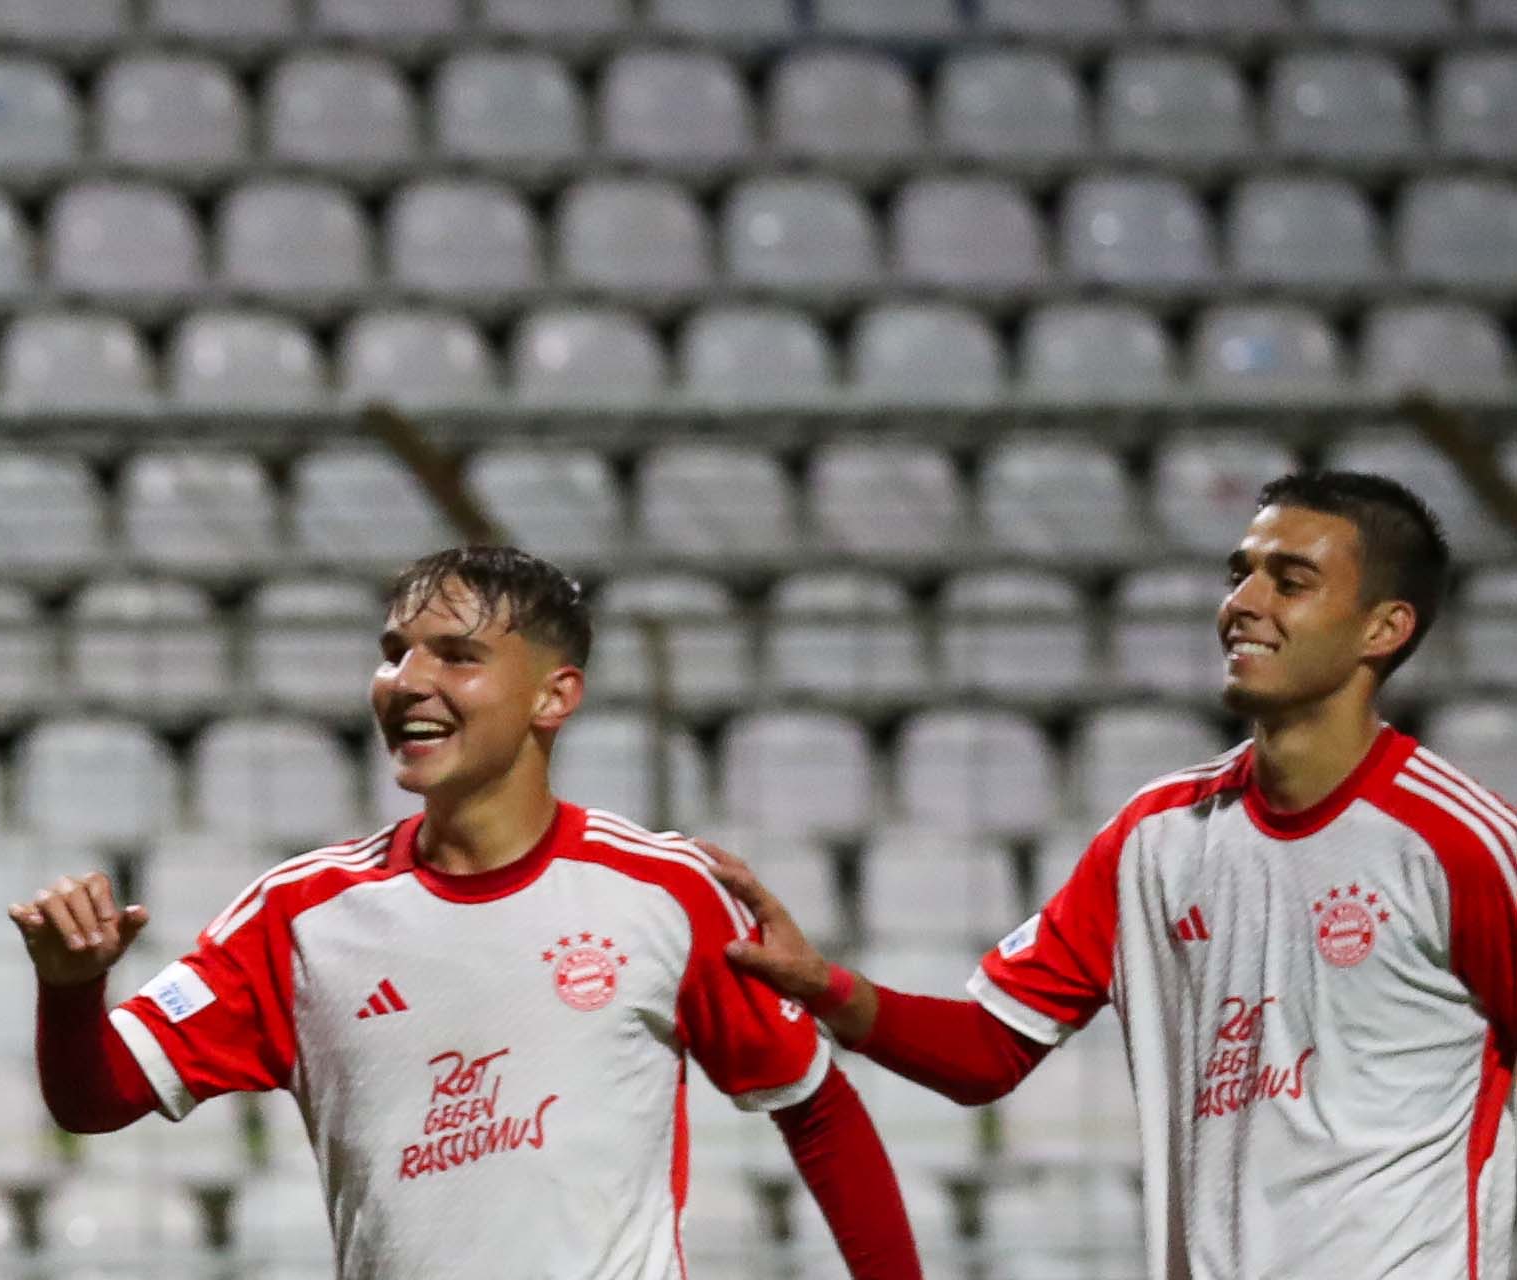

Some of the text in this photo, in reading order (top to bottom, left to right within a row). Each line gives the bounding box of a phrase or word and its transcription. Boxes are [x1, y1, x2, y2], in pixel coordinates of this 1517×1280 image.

[423, 1074, 502, 1136] GEGEN
[427, 1047, 511, 1104] ROT
[398, 1094, 560, 1182] RASSISMUS
